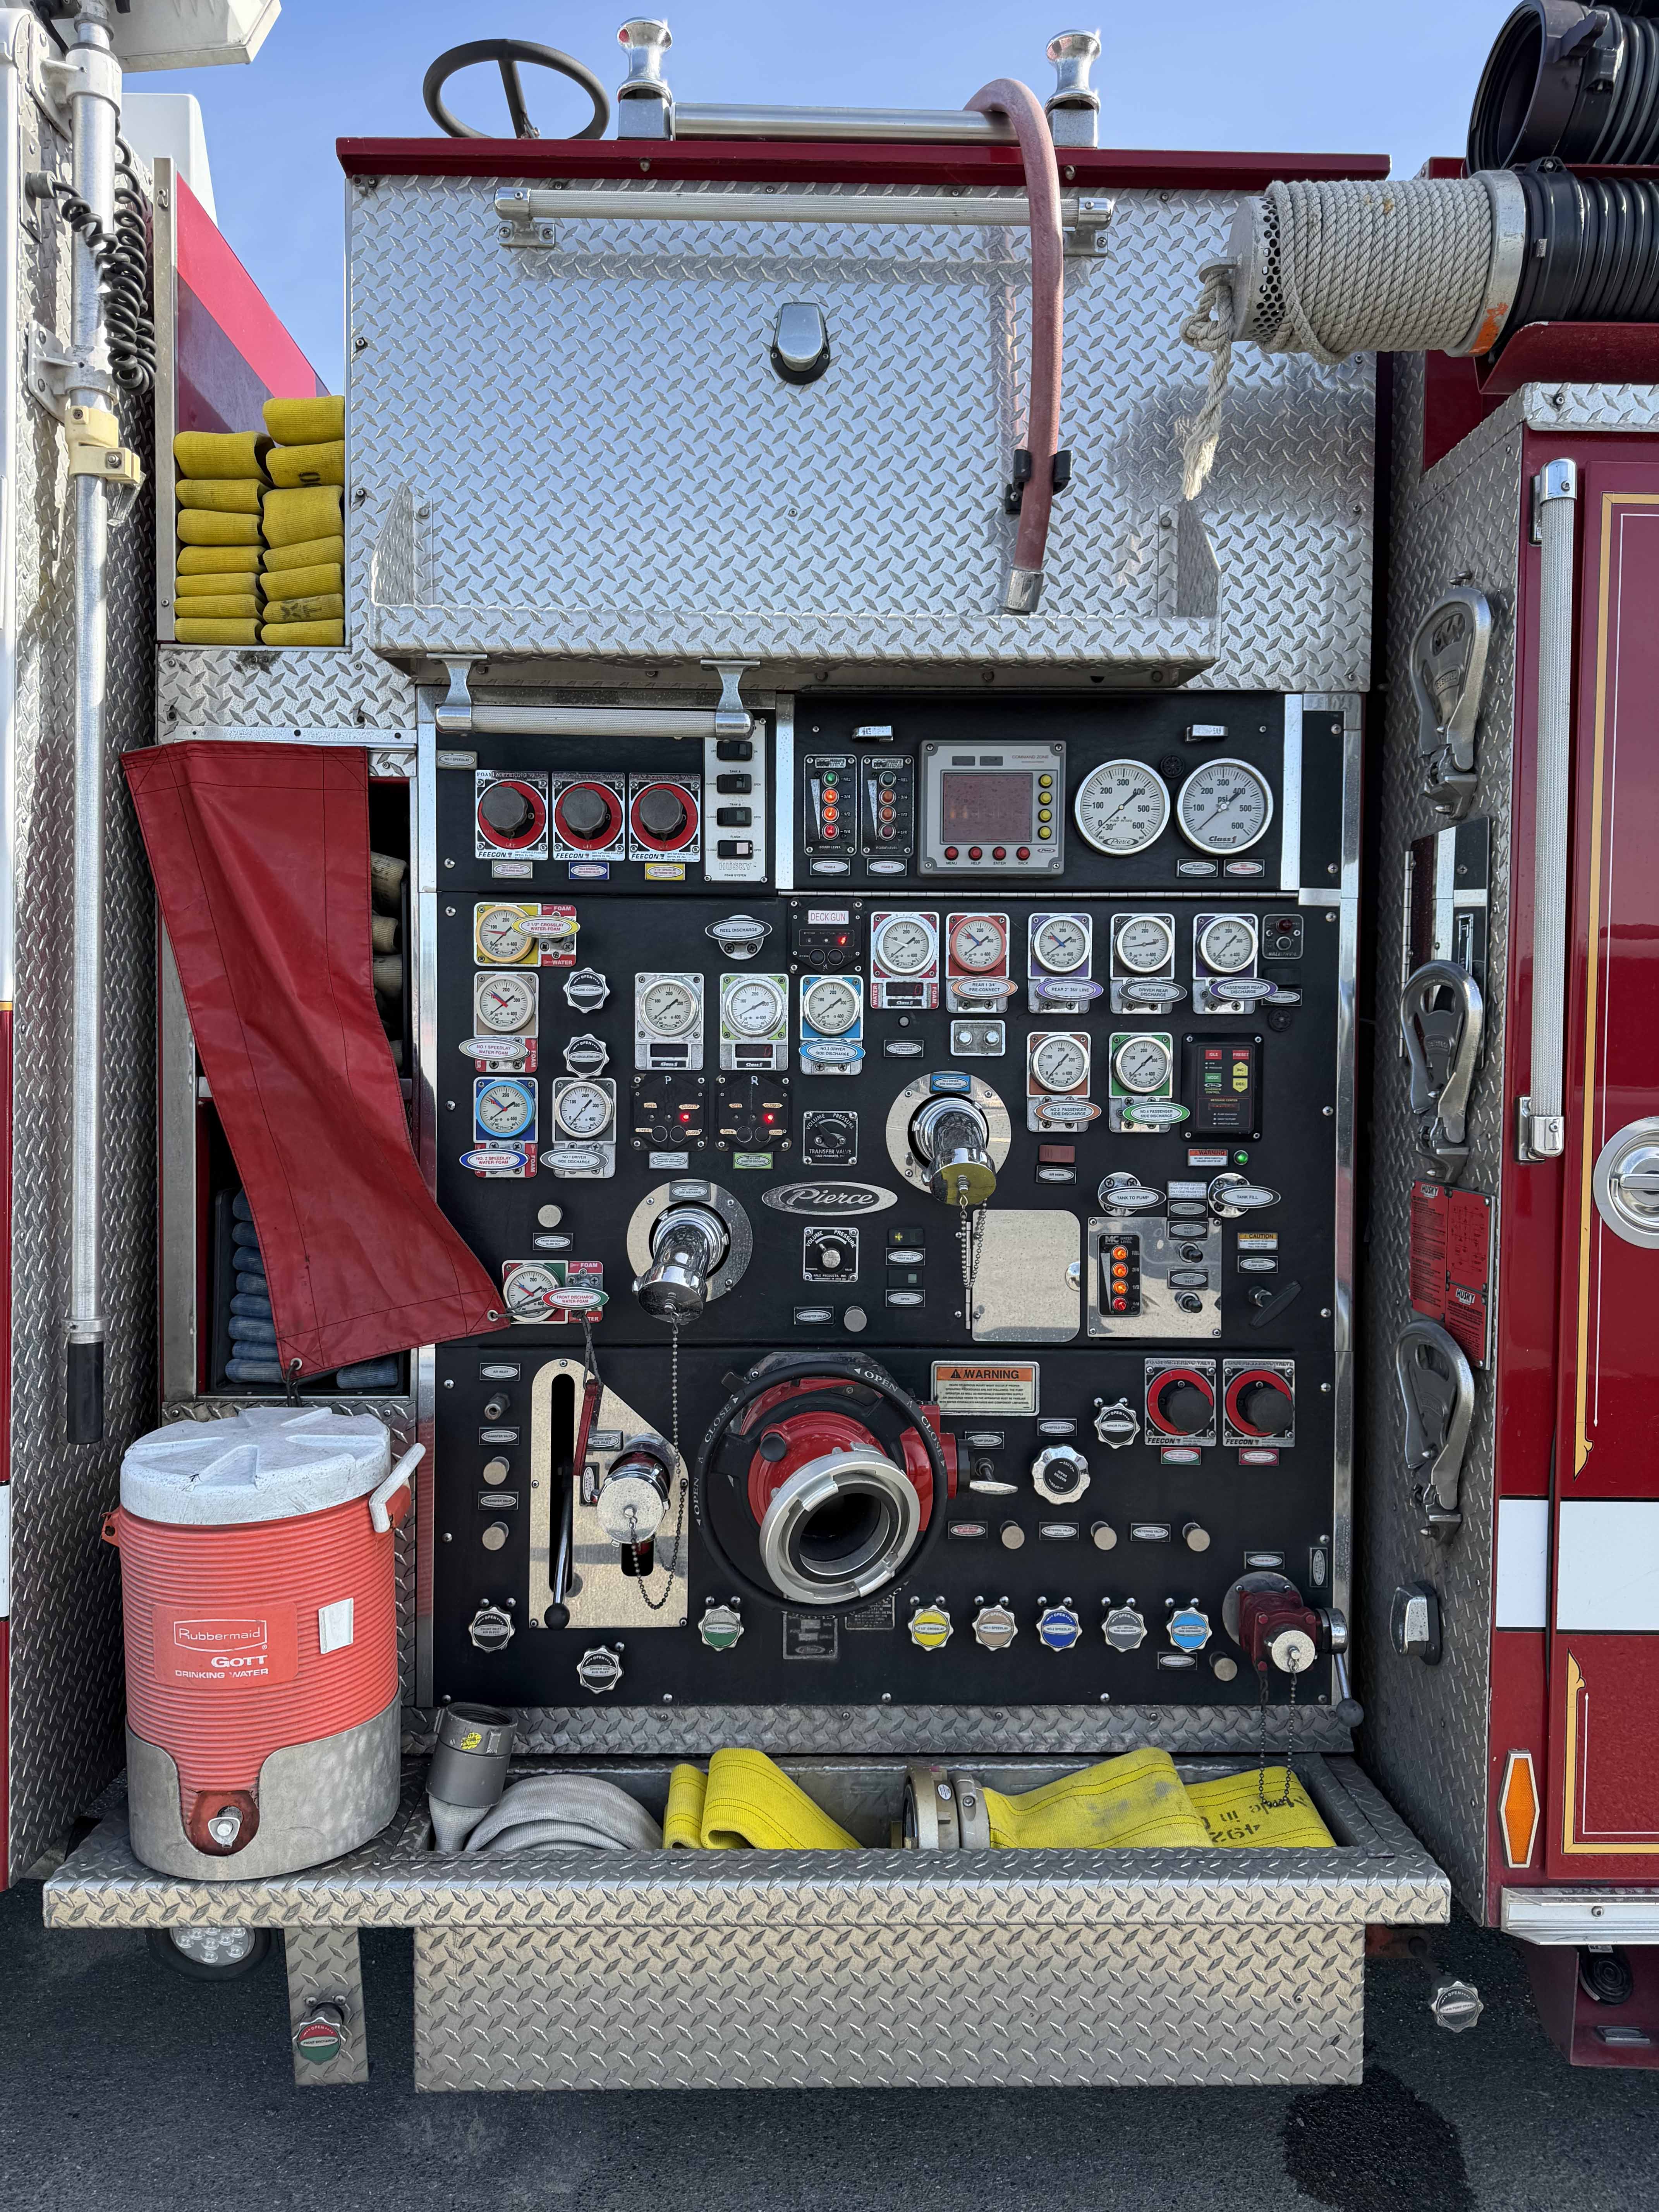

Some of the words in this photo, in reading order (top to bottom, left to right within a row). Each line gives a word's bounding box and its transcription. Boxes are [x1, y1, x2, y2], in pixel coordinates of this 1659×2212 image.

[811, 913, 829, 922] DECK
[831, 913, 845, 921] GUN
[665, 1076, 672, 1085] P
[751, 1076, 758, 1085] R
[805, 1113, 825, 1130] VOLUME
[833, 1112, 854, 1130] PRESSURE
[787, 1188, 874, 1206] Pierce
[1422, 1186, 1437, 1195] HUSKY
[805, 1230, 824, 1247] VOLUME
[834, 1229, 856, 1249] PRESSURE
[1456, 1289, 1475, 1304] HUSKY
[864, 1370, 899, 1393] OPEN
[965, 1370, 1019, 1379] WARNING
[704, 1405, 732, 1443] CLOSE
[920, 1415, 943, 1458] CLOSE
[179, 1626, 261, 1641] Rubbermaid
[211, 1654, 269, 1668] GOTT
[175, 1669, 225, 1678] DRINKING
[230, 1668, 269, 1678] WATER
